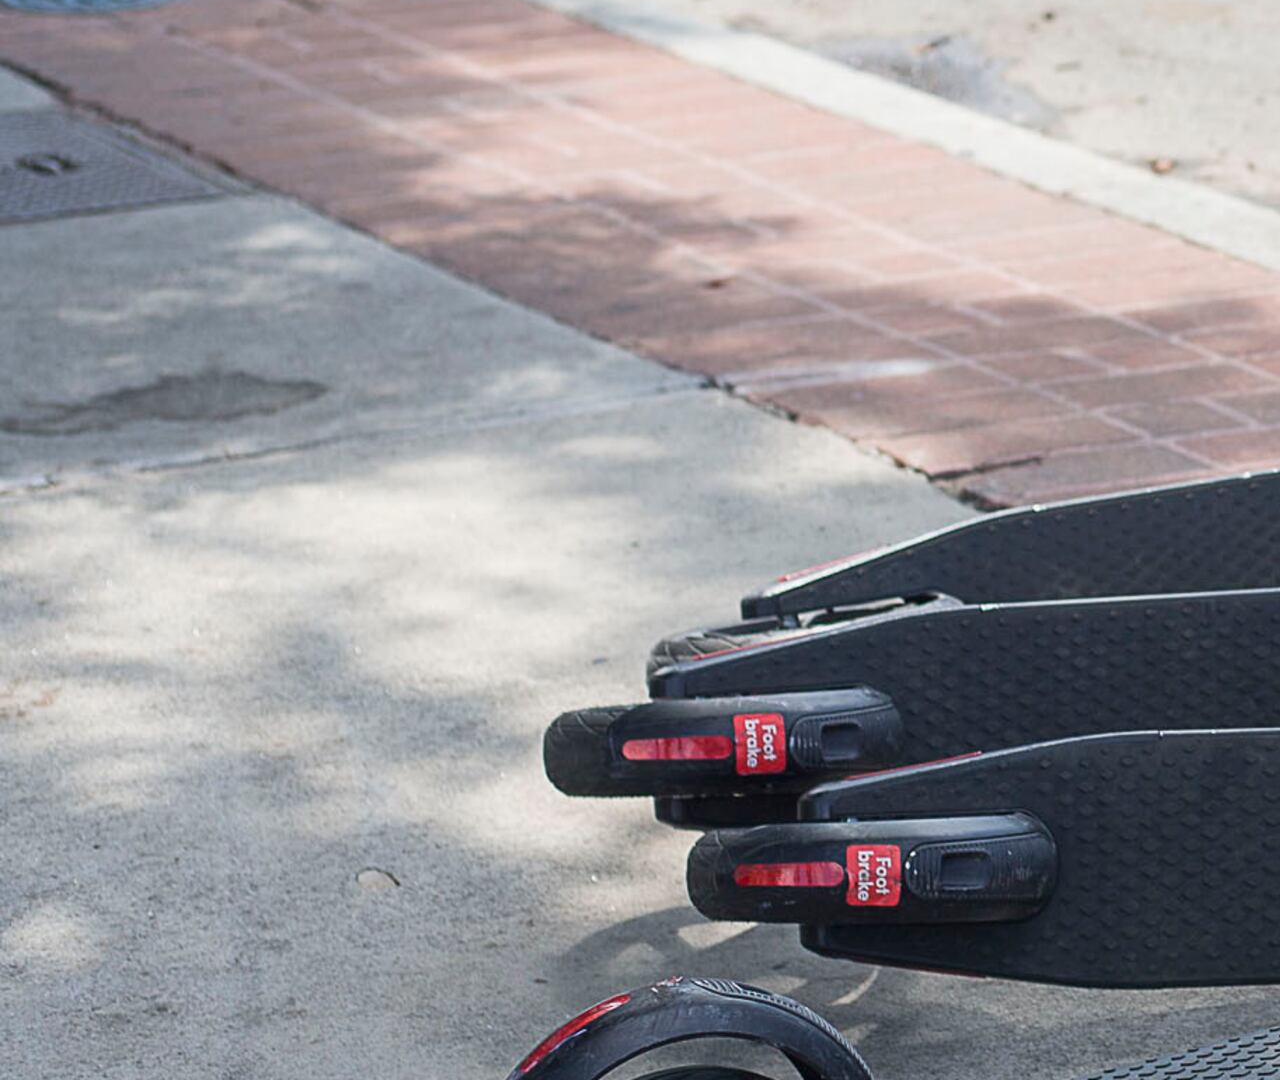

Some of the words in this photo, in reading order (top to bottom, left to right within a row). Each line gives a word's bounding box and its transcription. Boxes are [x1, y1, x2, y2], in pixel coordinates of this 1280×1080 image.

[745, 719, 762, 768] brake
[761, 723, 777, 761] Foot
[857, 850, 874, 901] brake
[875, 856, 892, 895] Foot
